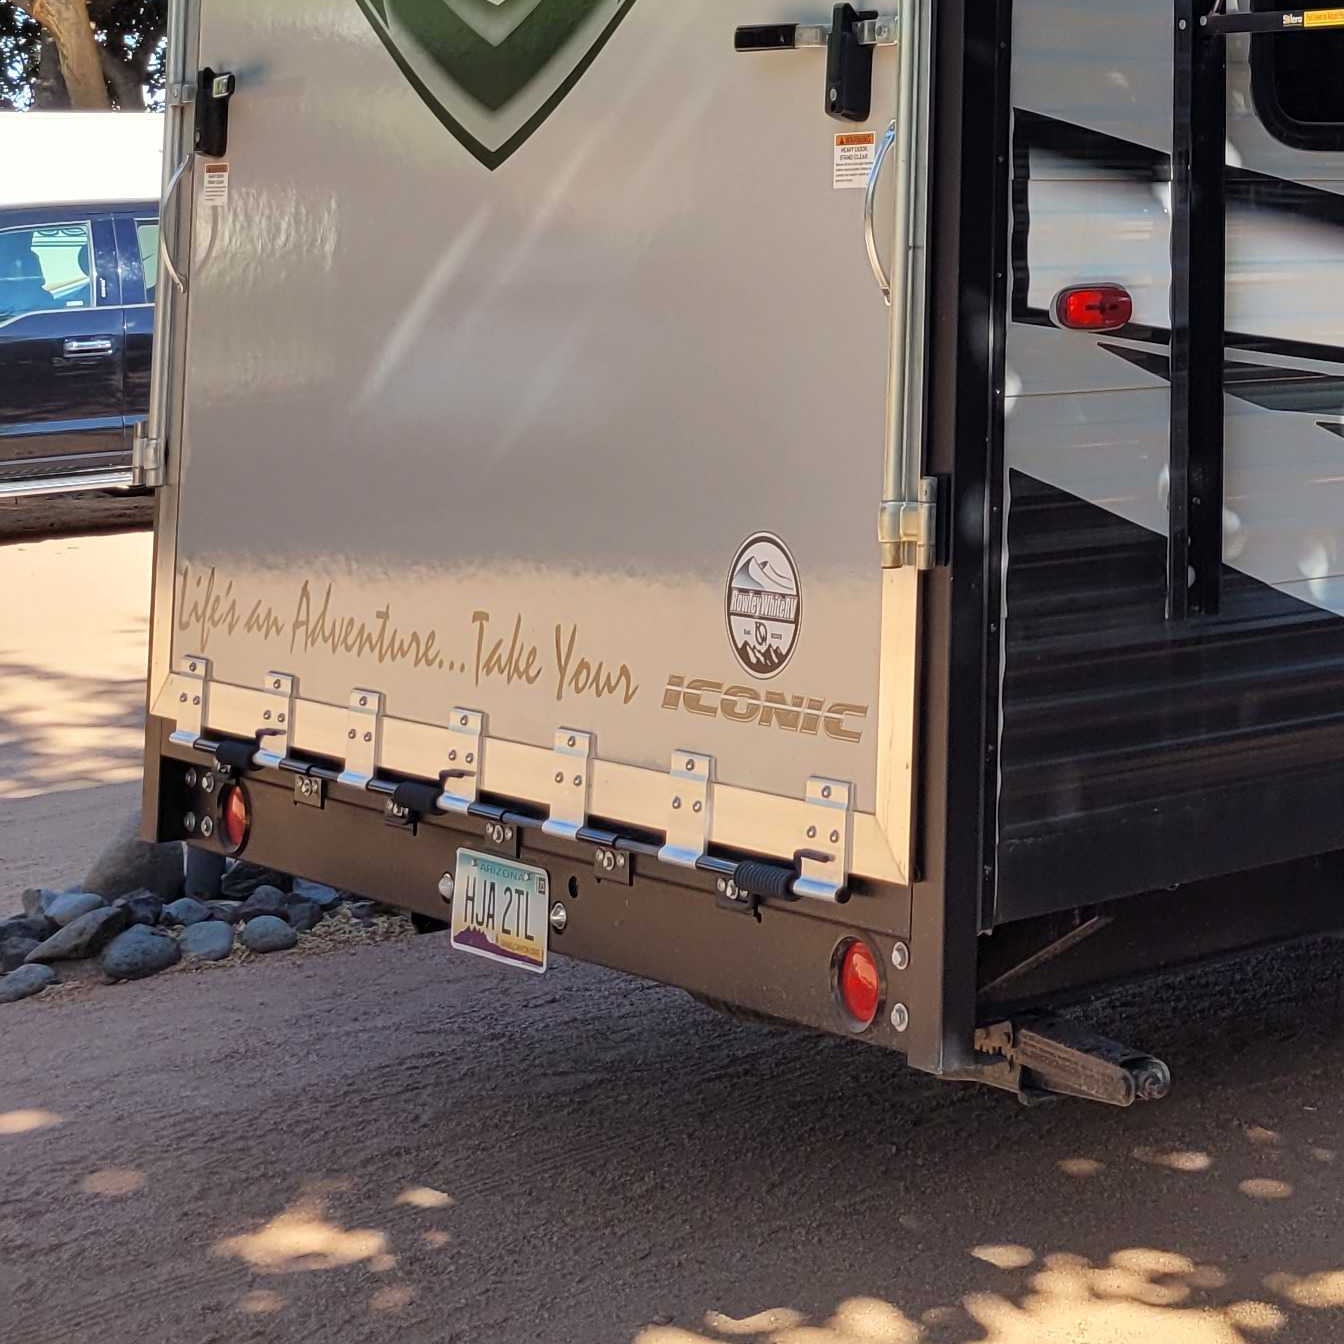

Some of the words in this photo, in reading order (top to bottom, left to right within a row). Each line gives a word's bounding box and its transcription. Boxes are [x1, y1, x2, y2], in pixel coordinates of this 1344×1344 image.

[178, 566, 240, 654] Life's
[245, 599, 284, 640] an
[555, 624, 639, 705] Your
[661, 673, 868, 743] ICONIC
[480, 863, 526, 882] ARIZONA
[464, 875, 496, 931] HJA
[501, 886, 535, 942] 2TL
